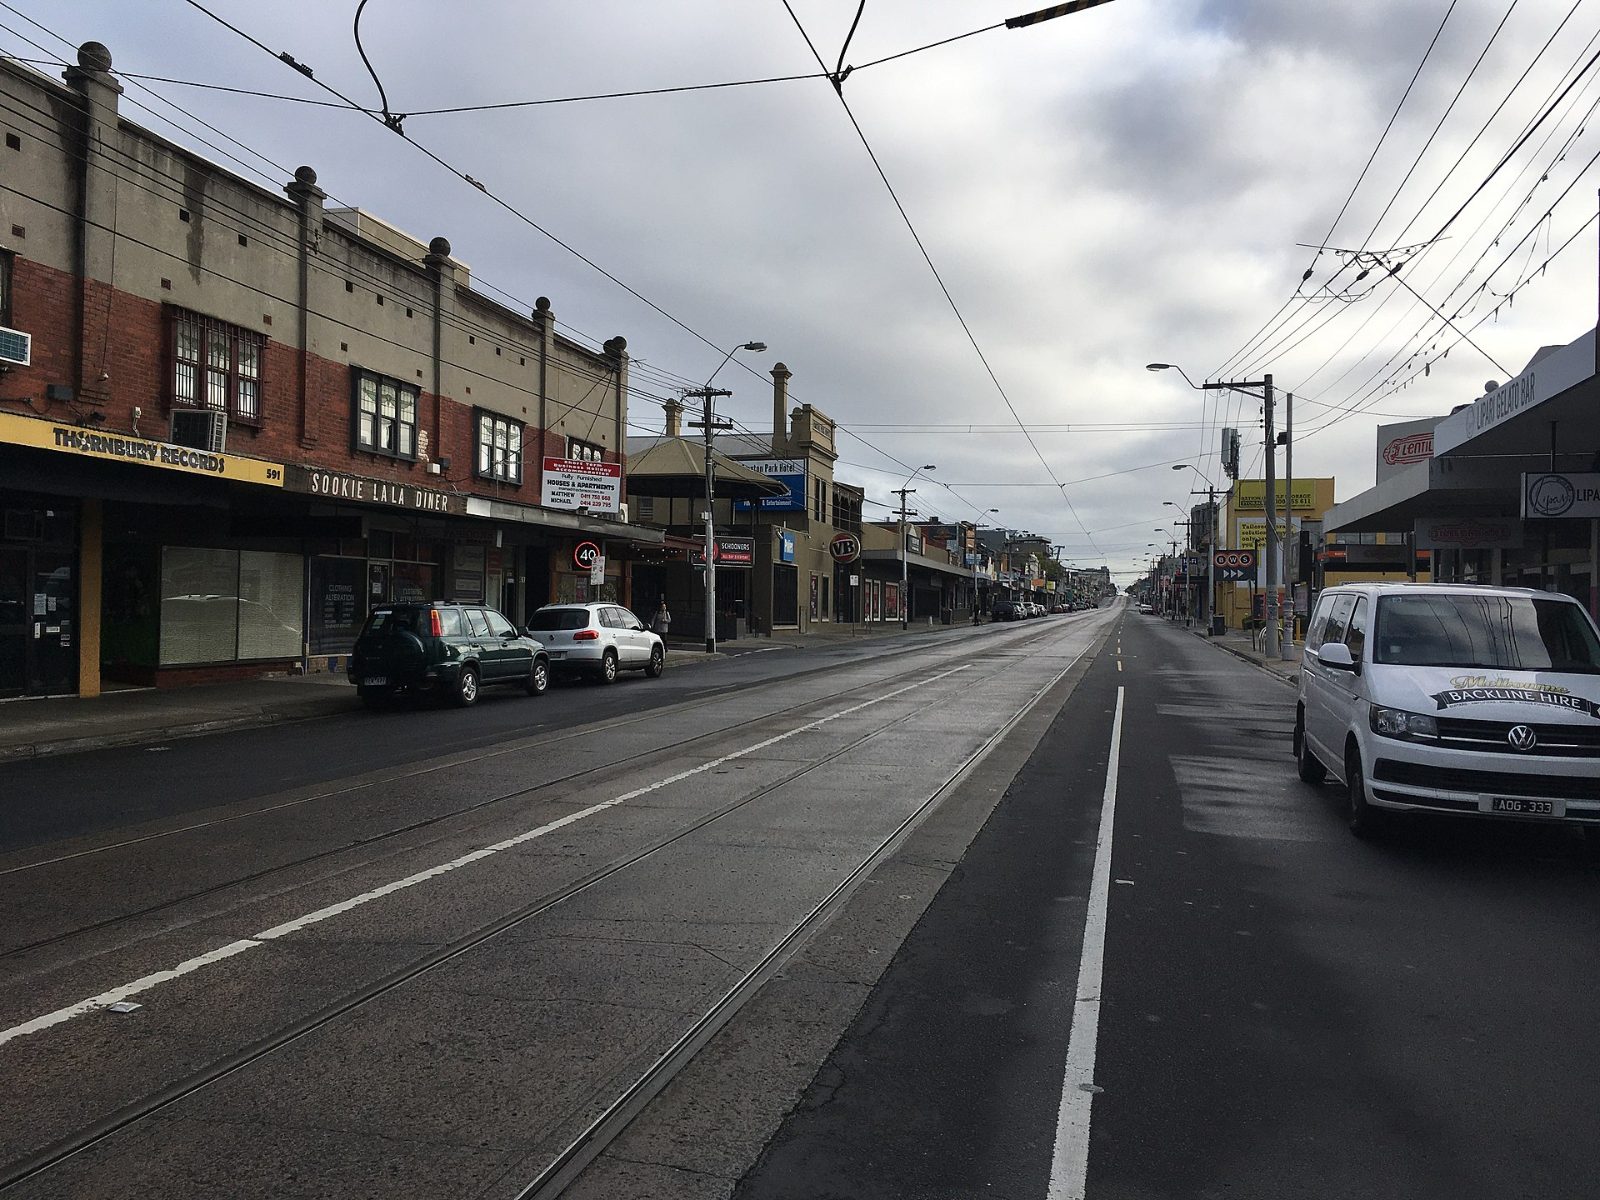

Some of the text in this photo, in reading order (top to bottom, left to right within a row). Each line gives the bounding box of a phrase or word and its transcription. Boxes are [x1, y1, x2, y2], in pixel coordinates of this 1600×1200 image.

[1476, 371, 1536, 430] LIPARI GELATO BAR
[53, 427, 281, 481] THORNBURY RECORDS 591
[765, 463, 779, 473] Park
[780, 463, 795, 473] Hotel
[576, 474, 603, 482] Furnished
[547, 479, 570, 487] HOUSES
[577, 483, 615, 491] APARTMENTS
[311, 472, 363, 500] SOOKIE
[415, 490, 448, 512] DINER
[721, 542, 750, 551] SCHOONERS
[833, 541, 855, 556] VB
[580, 549, 596, 561] 40
[328, 584, 353, 593] CLOTHING
[1448, 689, 1581, 708] BACKLINE HIRE
